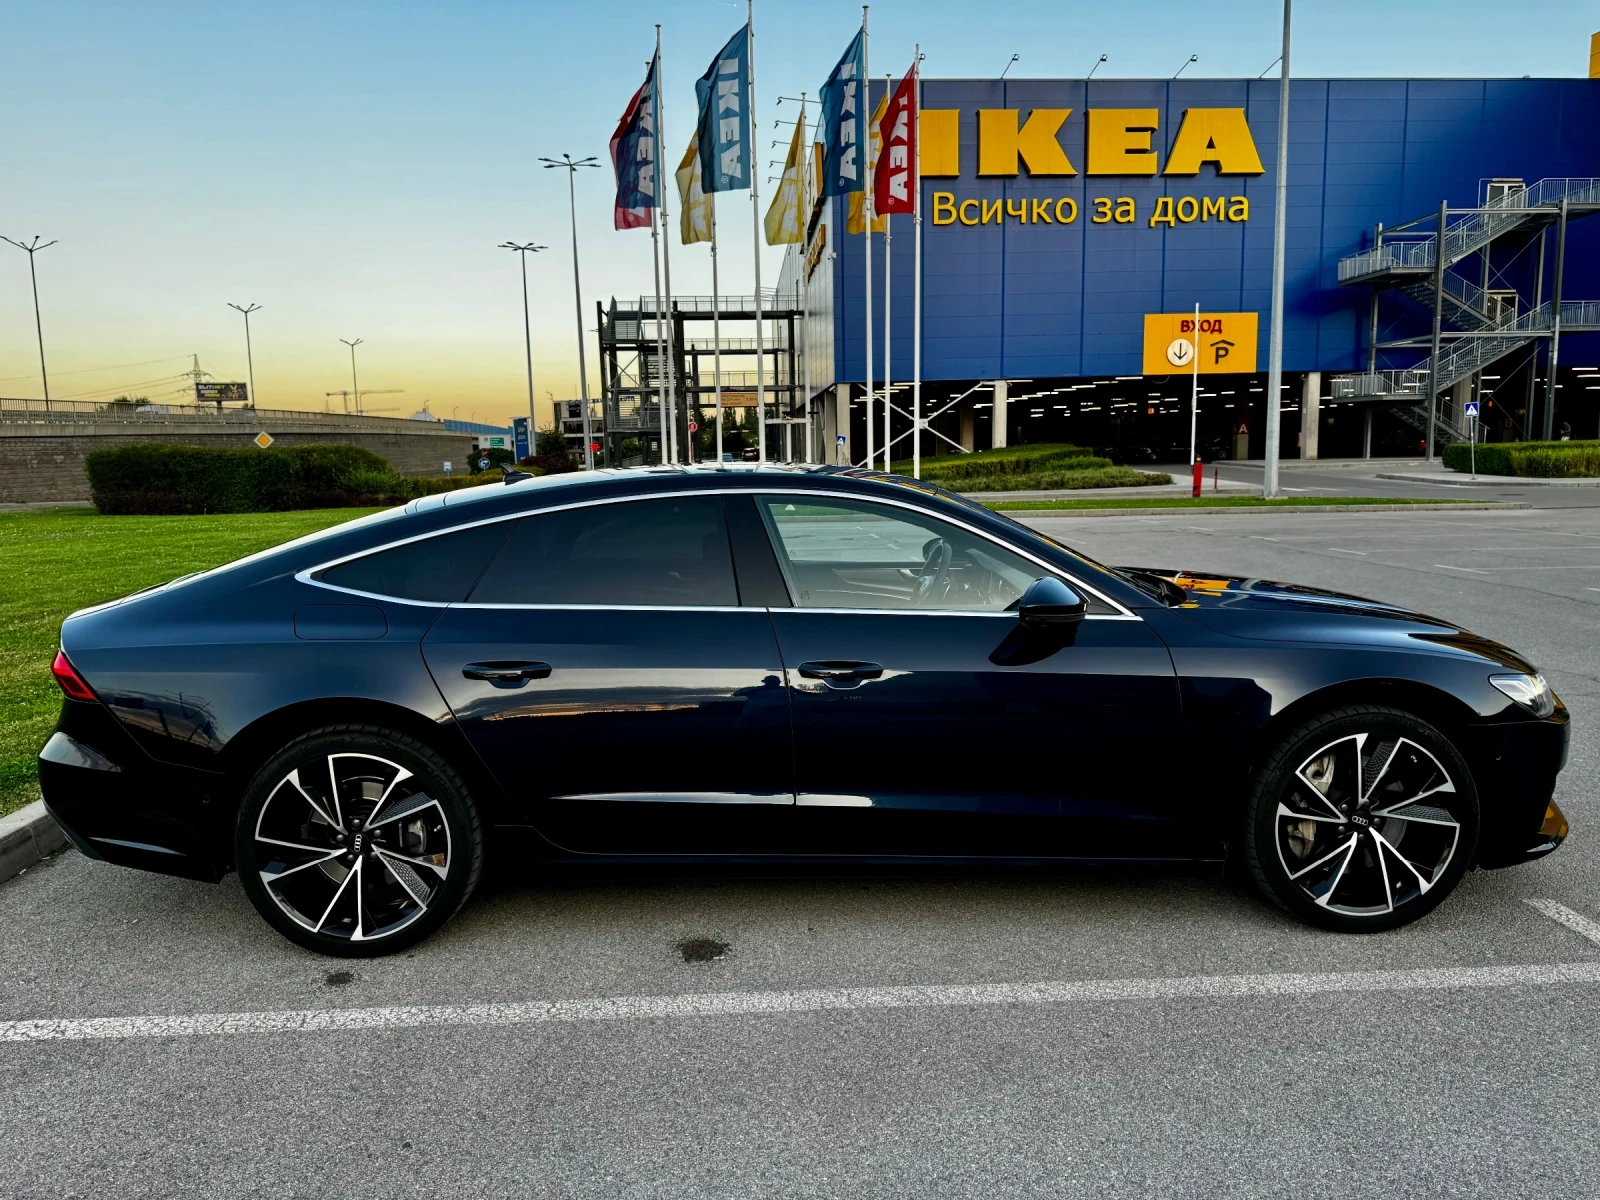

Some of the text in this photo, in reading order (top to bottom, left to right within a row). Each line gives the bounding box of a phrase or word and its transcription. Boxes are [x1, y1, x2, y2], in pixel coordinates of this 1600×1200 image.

[919, 107, 1266, 178] IKEA
[932, 192, 1249, 227] Всичко за дома
[1181, 319, 1223, 335] ВХОД
